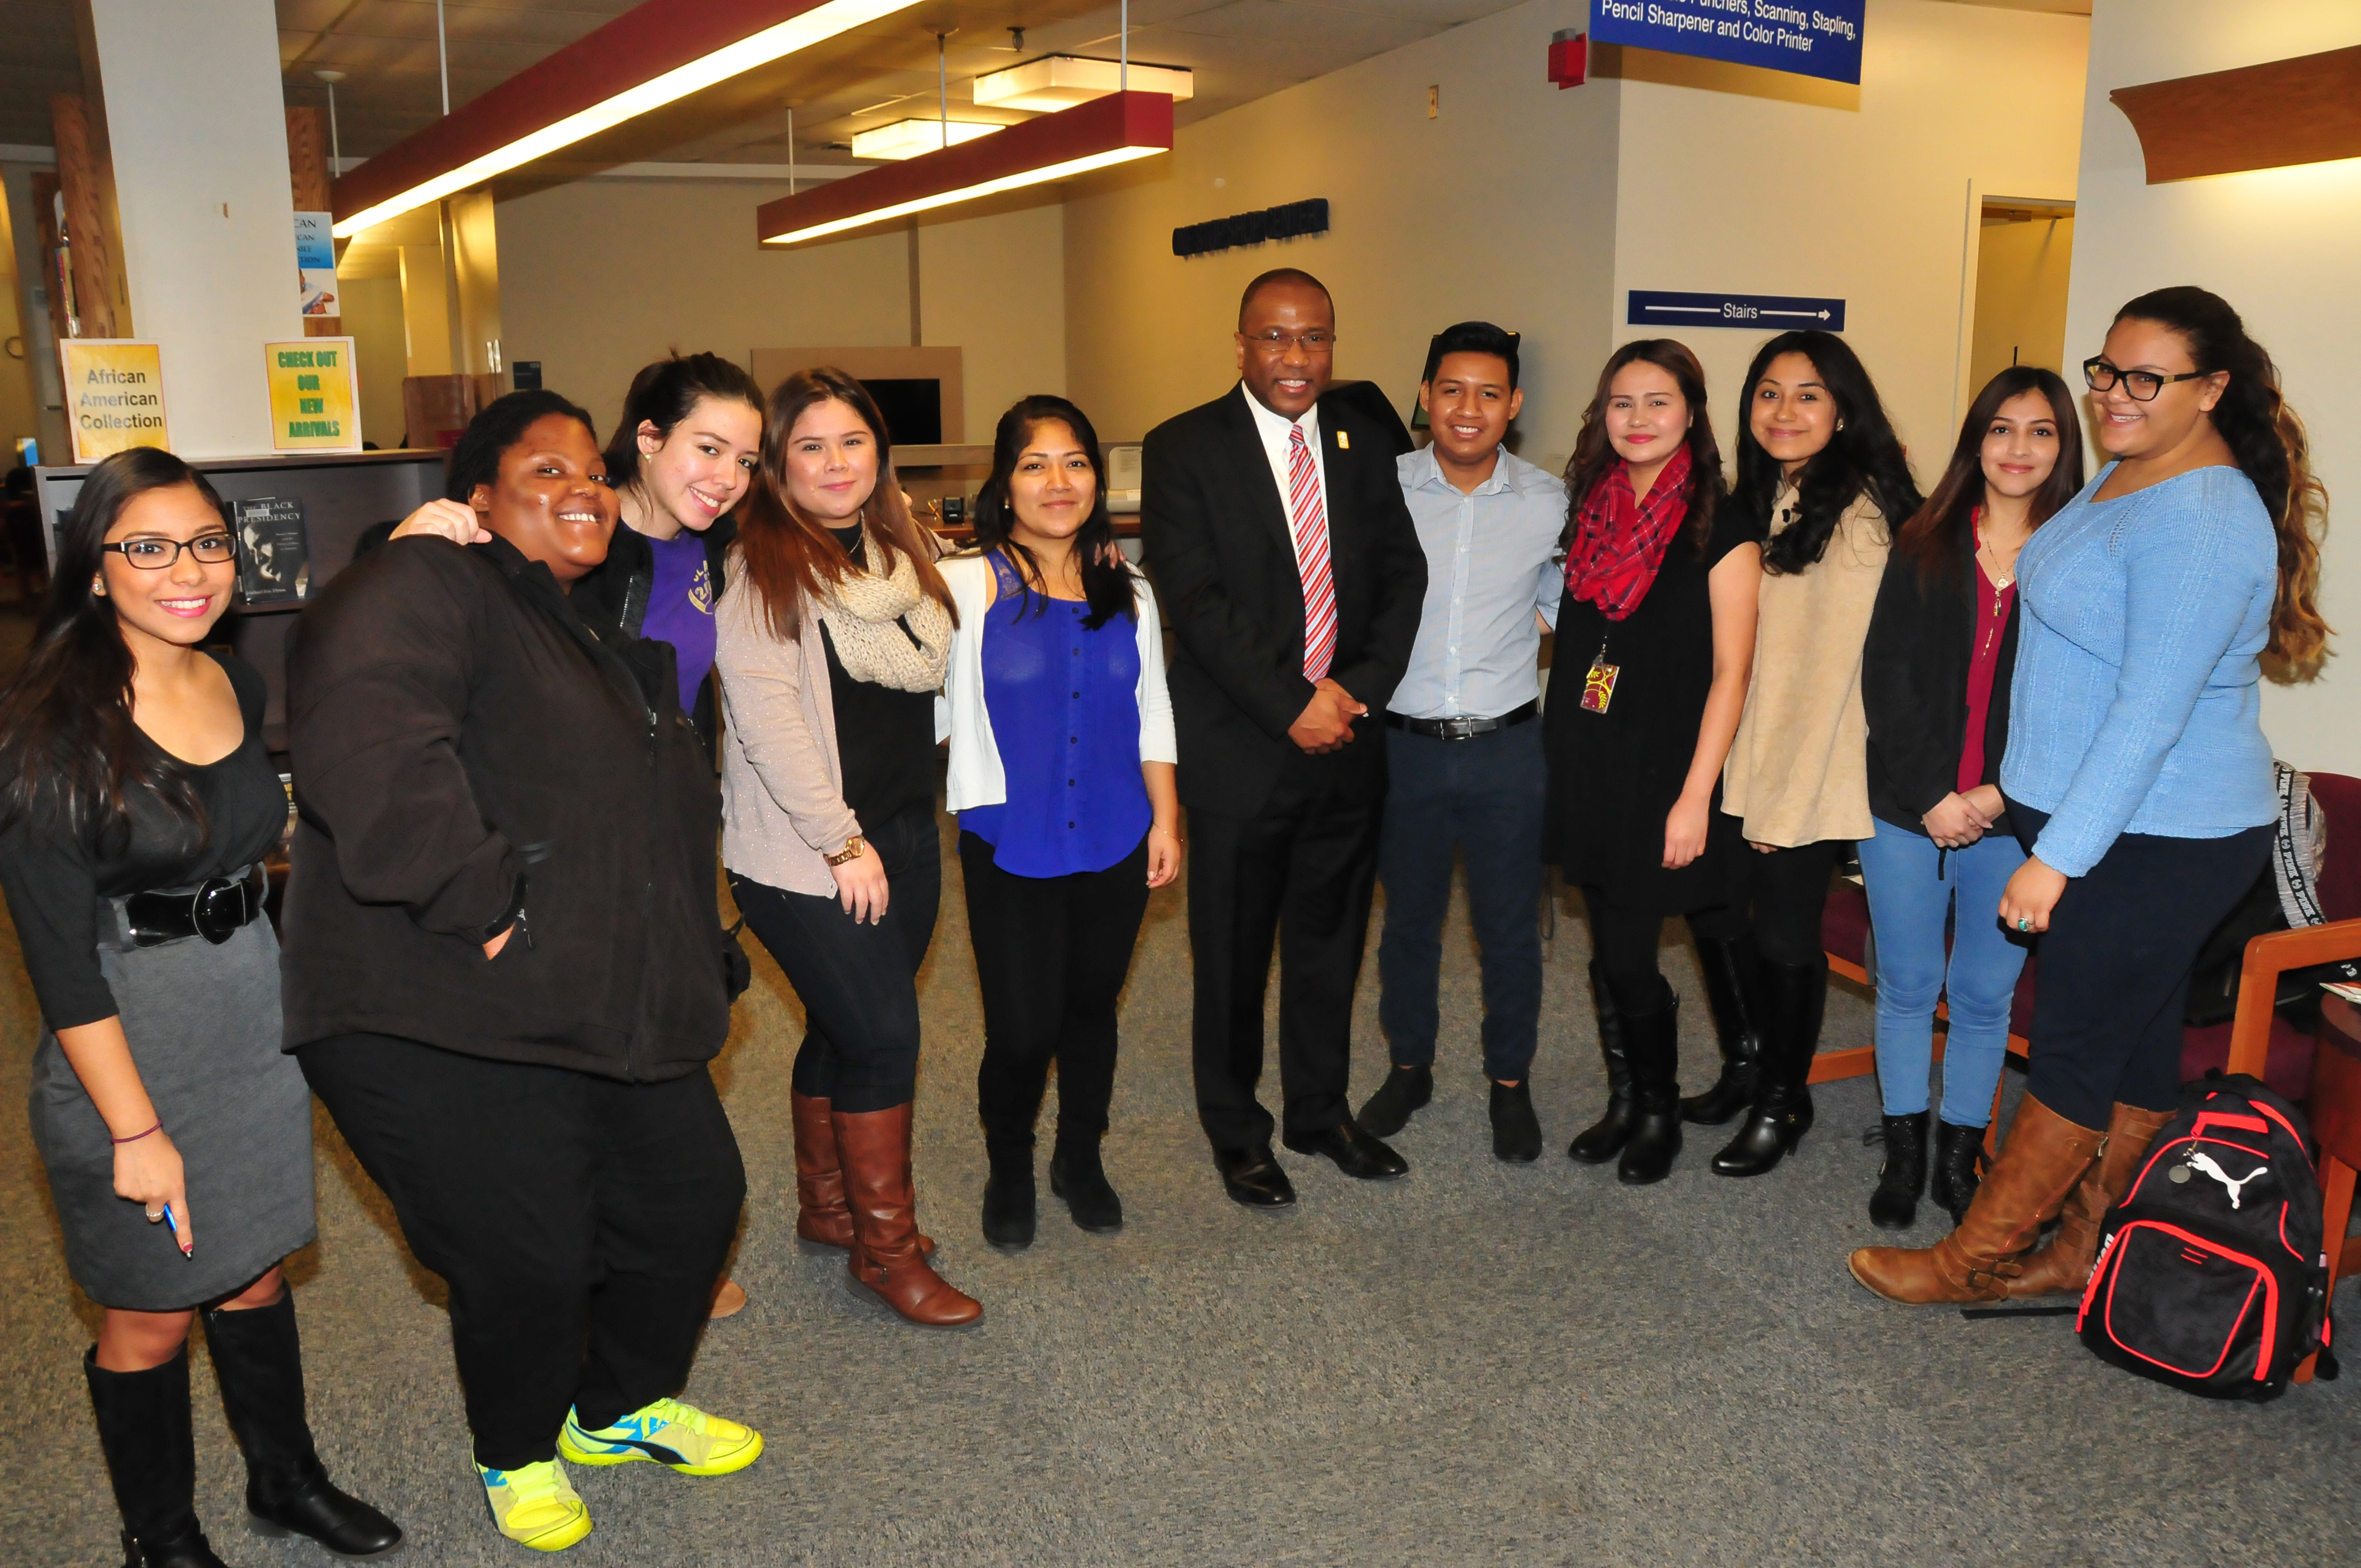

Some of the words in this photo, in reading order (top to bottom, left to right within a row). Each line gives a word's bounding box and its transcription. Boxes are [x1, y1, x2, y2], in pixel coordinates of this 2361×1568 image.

[1602, 0, 1644, 21] Pencil
[1648, 4, 1715, 32] Sharpener
[1717, 20, 1740, 38] and
[1743, 21, 1774, 44] Color
[1777, 28, 1814, 52] Printer
[1691, 0, 1750, 18] unchers,
[1754, 0, 1809, 30] Scanning,
[1813, 10, 1856, 41] Stapling,
[1723, 303, 1758, 319] Stairs
[278, 351, 314, 368] CHECK
[316, 351, 338, 367] OUT
[87, 369, 146, 384] African
[297, 375, 320, 391] OUR
[80, 392, 157, 407] American
[300, 398, 324, 413] NEW
[80, 413, 162, 429] Collection
[289, 421, 340, 438] ARRIVALS
[261, 502, 293, 510] BLACK
[237, 513, 301, 523] PRESIDENCY
[2280, 774, 2291, 797] PINK
[2283, 851, 2299, 878] PINK
[2295, 890, 2316, 917] PINK
